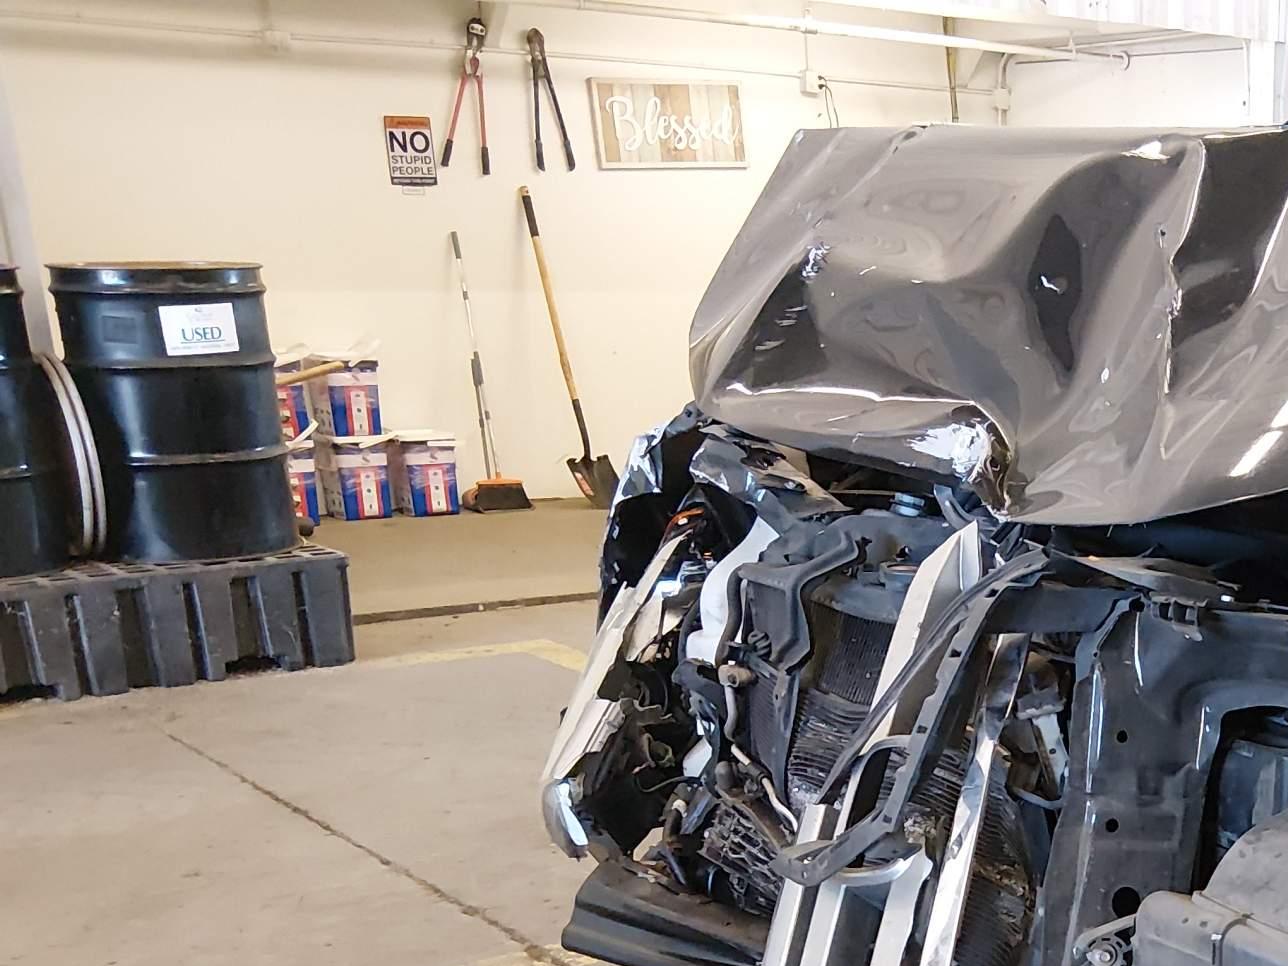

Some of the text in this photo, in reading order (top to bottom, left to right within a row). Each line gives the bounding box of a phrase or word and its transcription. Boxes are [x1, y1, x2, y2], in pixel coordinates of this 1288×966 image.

[605, 95, 740, 151] Blessed
[388, 131, 430, 154] NO
[391, 155, 432, 165] STUPID
[392, 166, 434, 176] PEOPLE
[181, 326, 223, 342] USED
